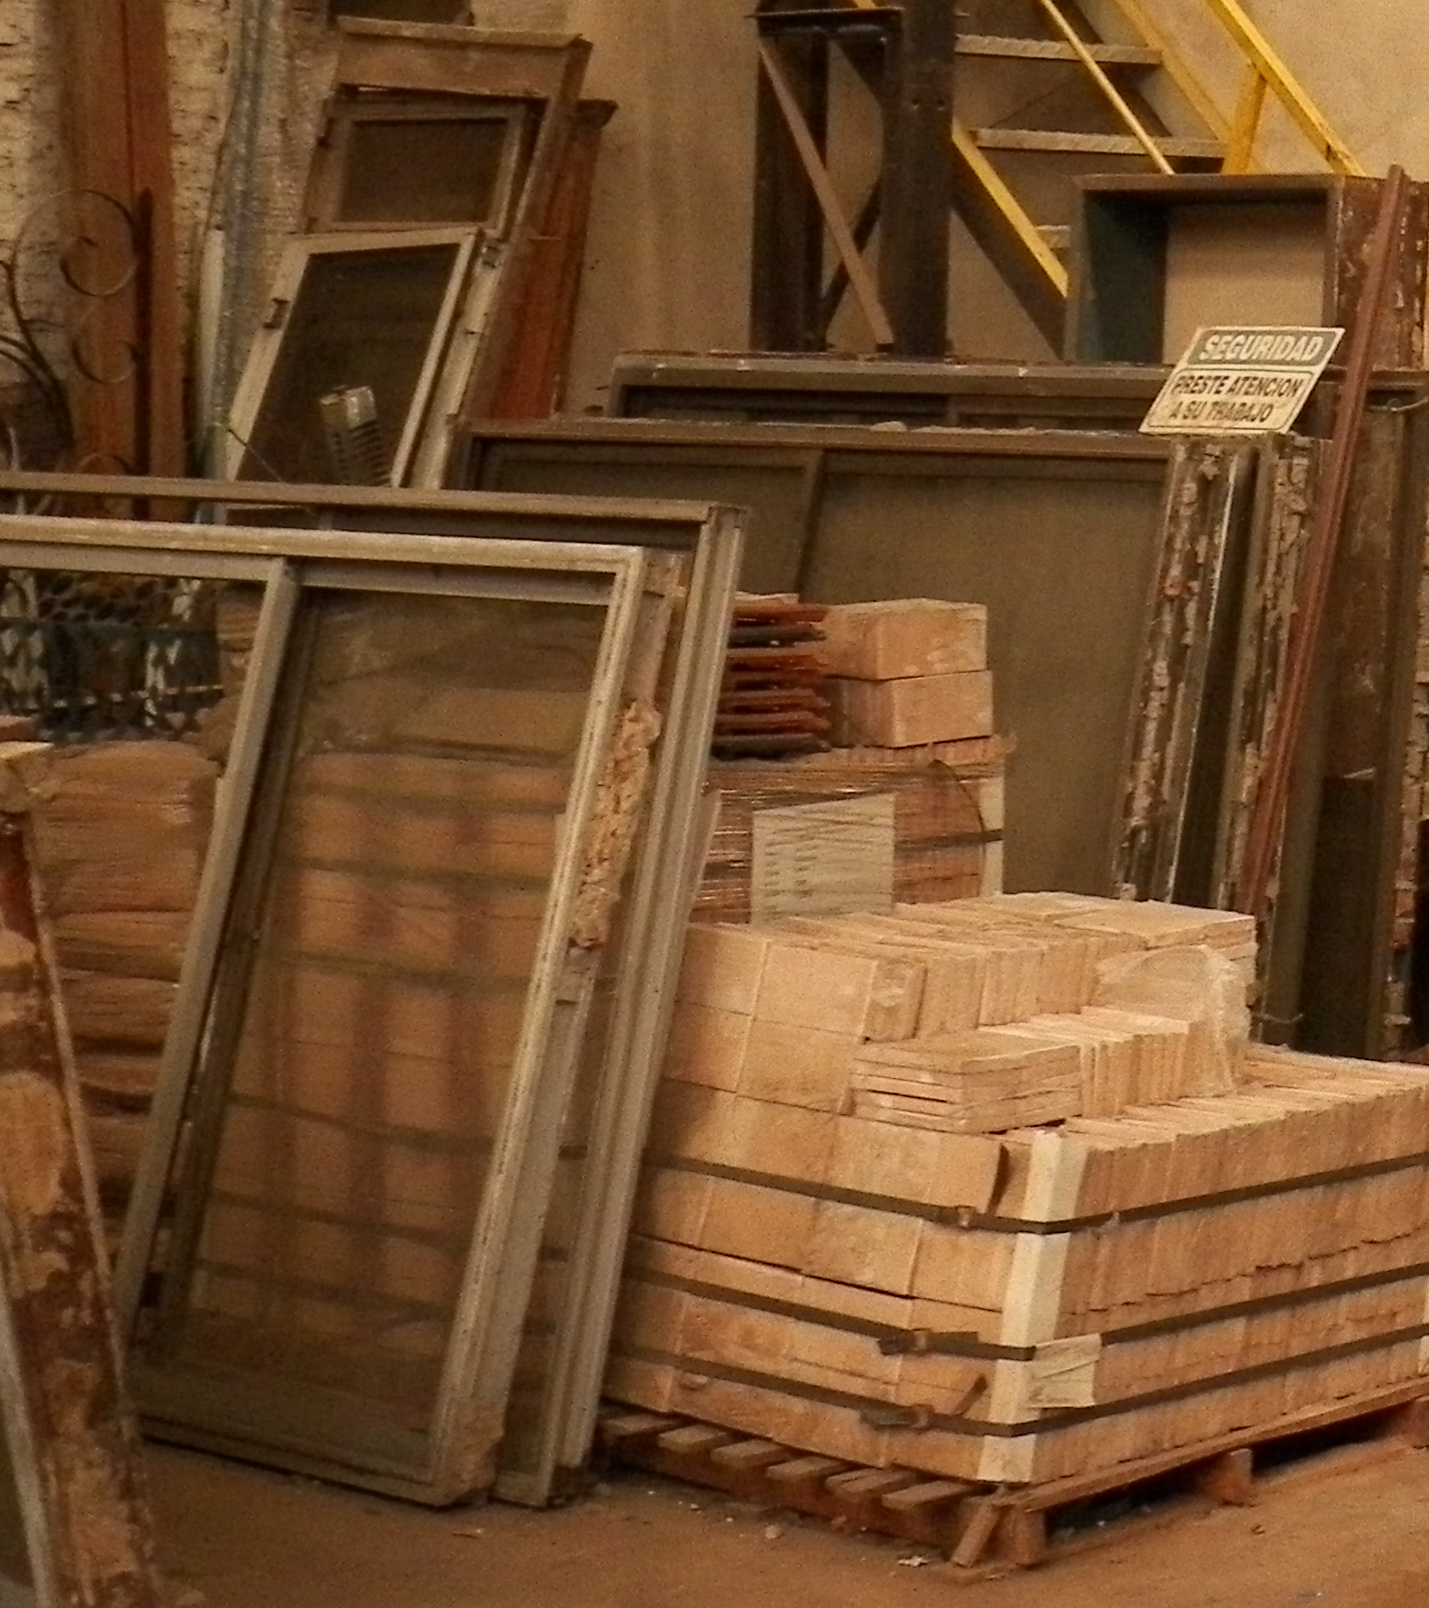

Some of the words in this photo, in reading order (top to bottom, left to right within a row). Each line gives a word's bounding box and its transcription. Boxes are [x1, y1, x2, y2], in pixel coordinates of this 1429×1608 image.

[1199, 333, 1326, 362] SEGURIDAD
[1171, 374, 1230, 395] PRESTE
[1227, 375, 1305, 399] ATENCION
[1169, 401, 1183, 418] A
[1183, 400, 1207, 421] SU
[1209, 402, 1274, 424] TRABAJO
